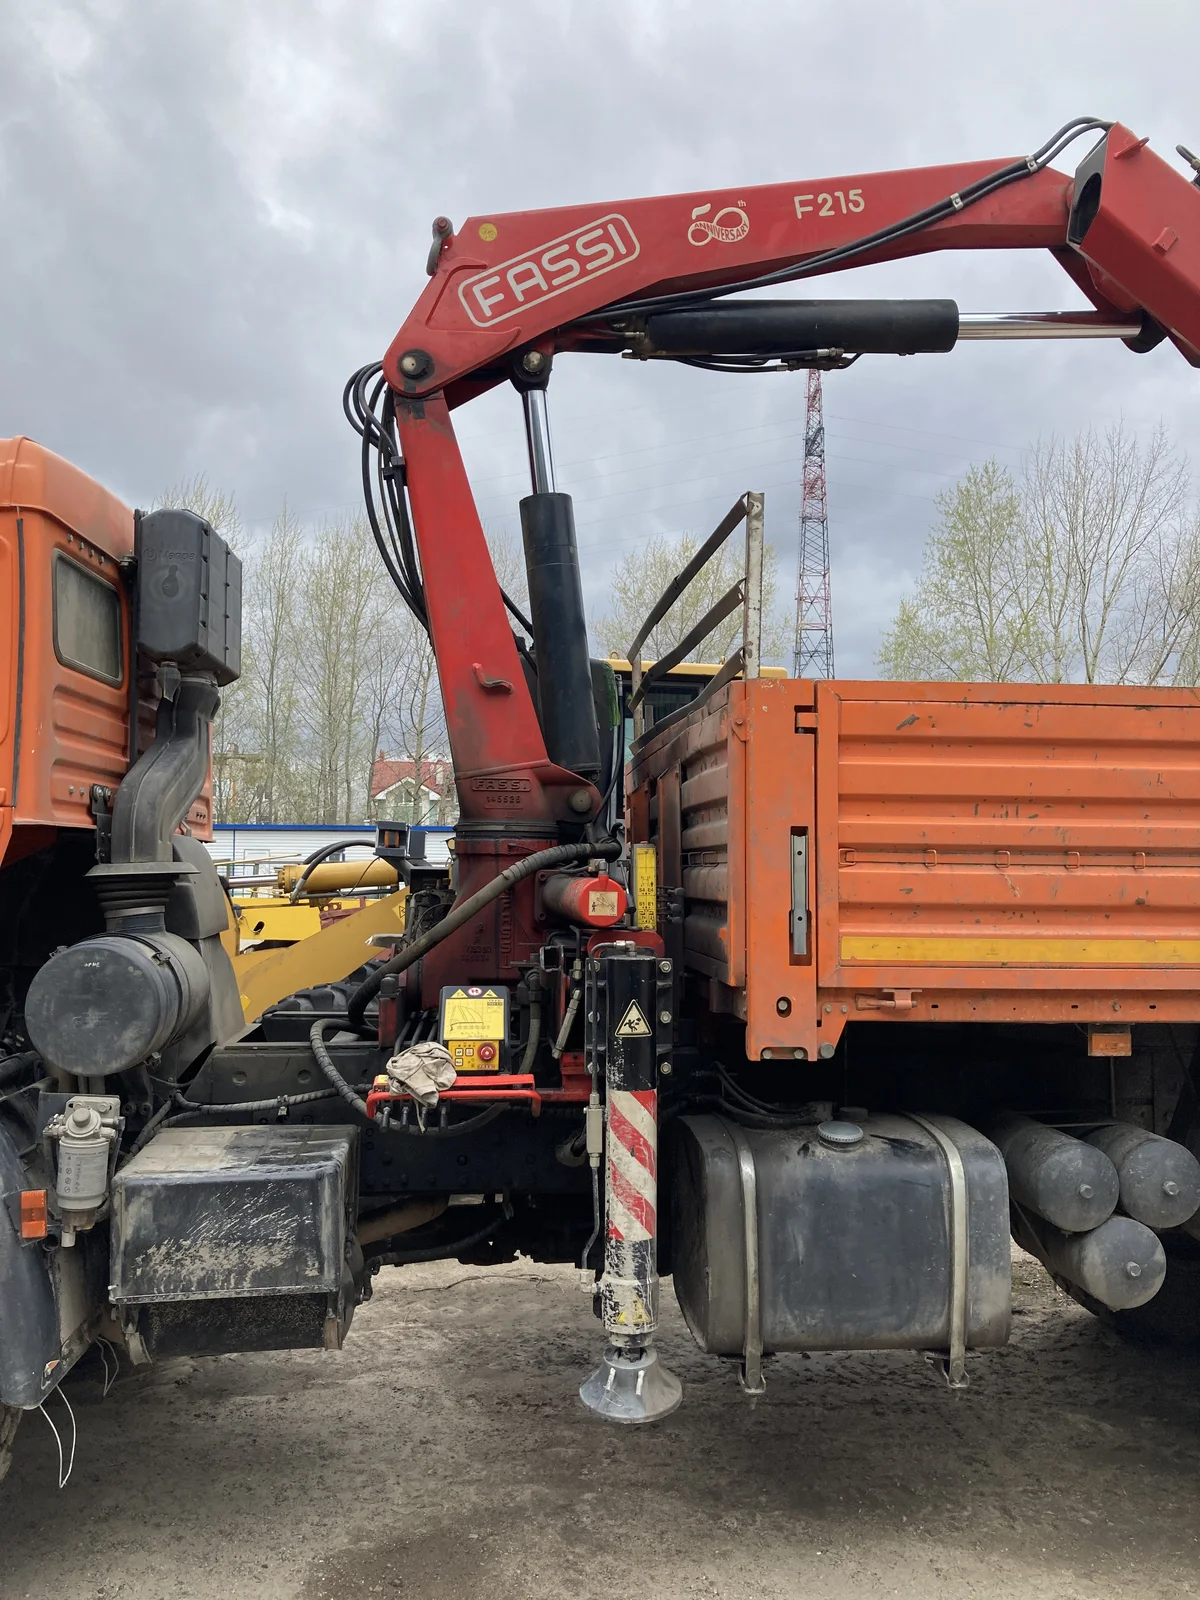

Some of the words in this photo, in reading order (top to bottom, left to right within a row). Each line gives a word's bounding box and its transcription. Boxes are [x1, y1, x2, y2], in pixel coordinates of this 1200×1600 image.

[793, 188, 865, 219] F215
[693, 221, 750, 242] ANNIVERSARY
[472, 223, 627, 317] FASSI
